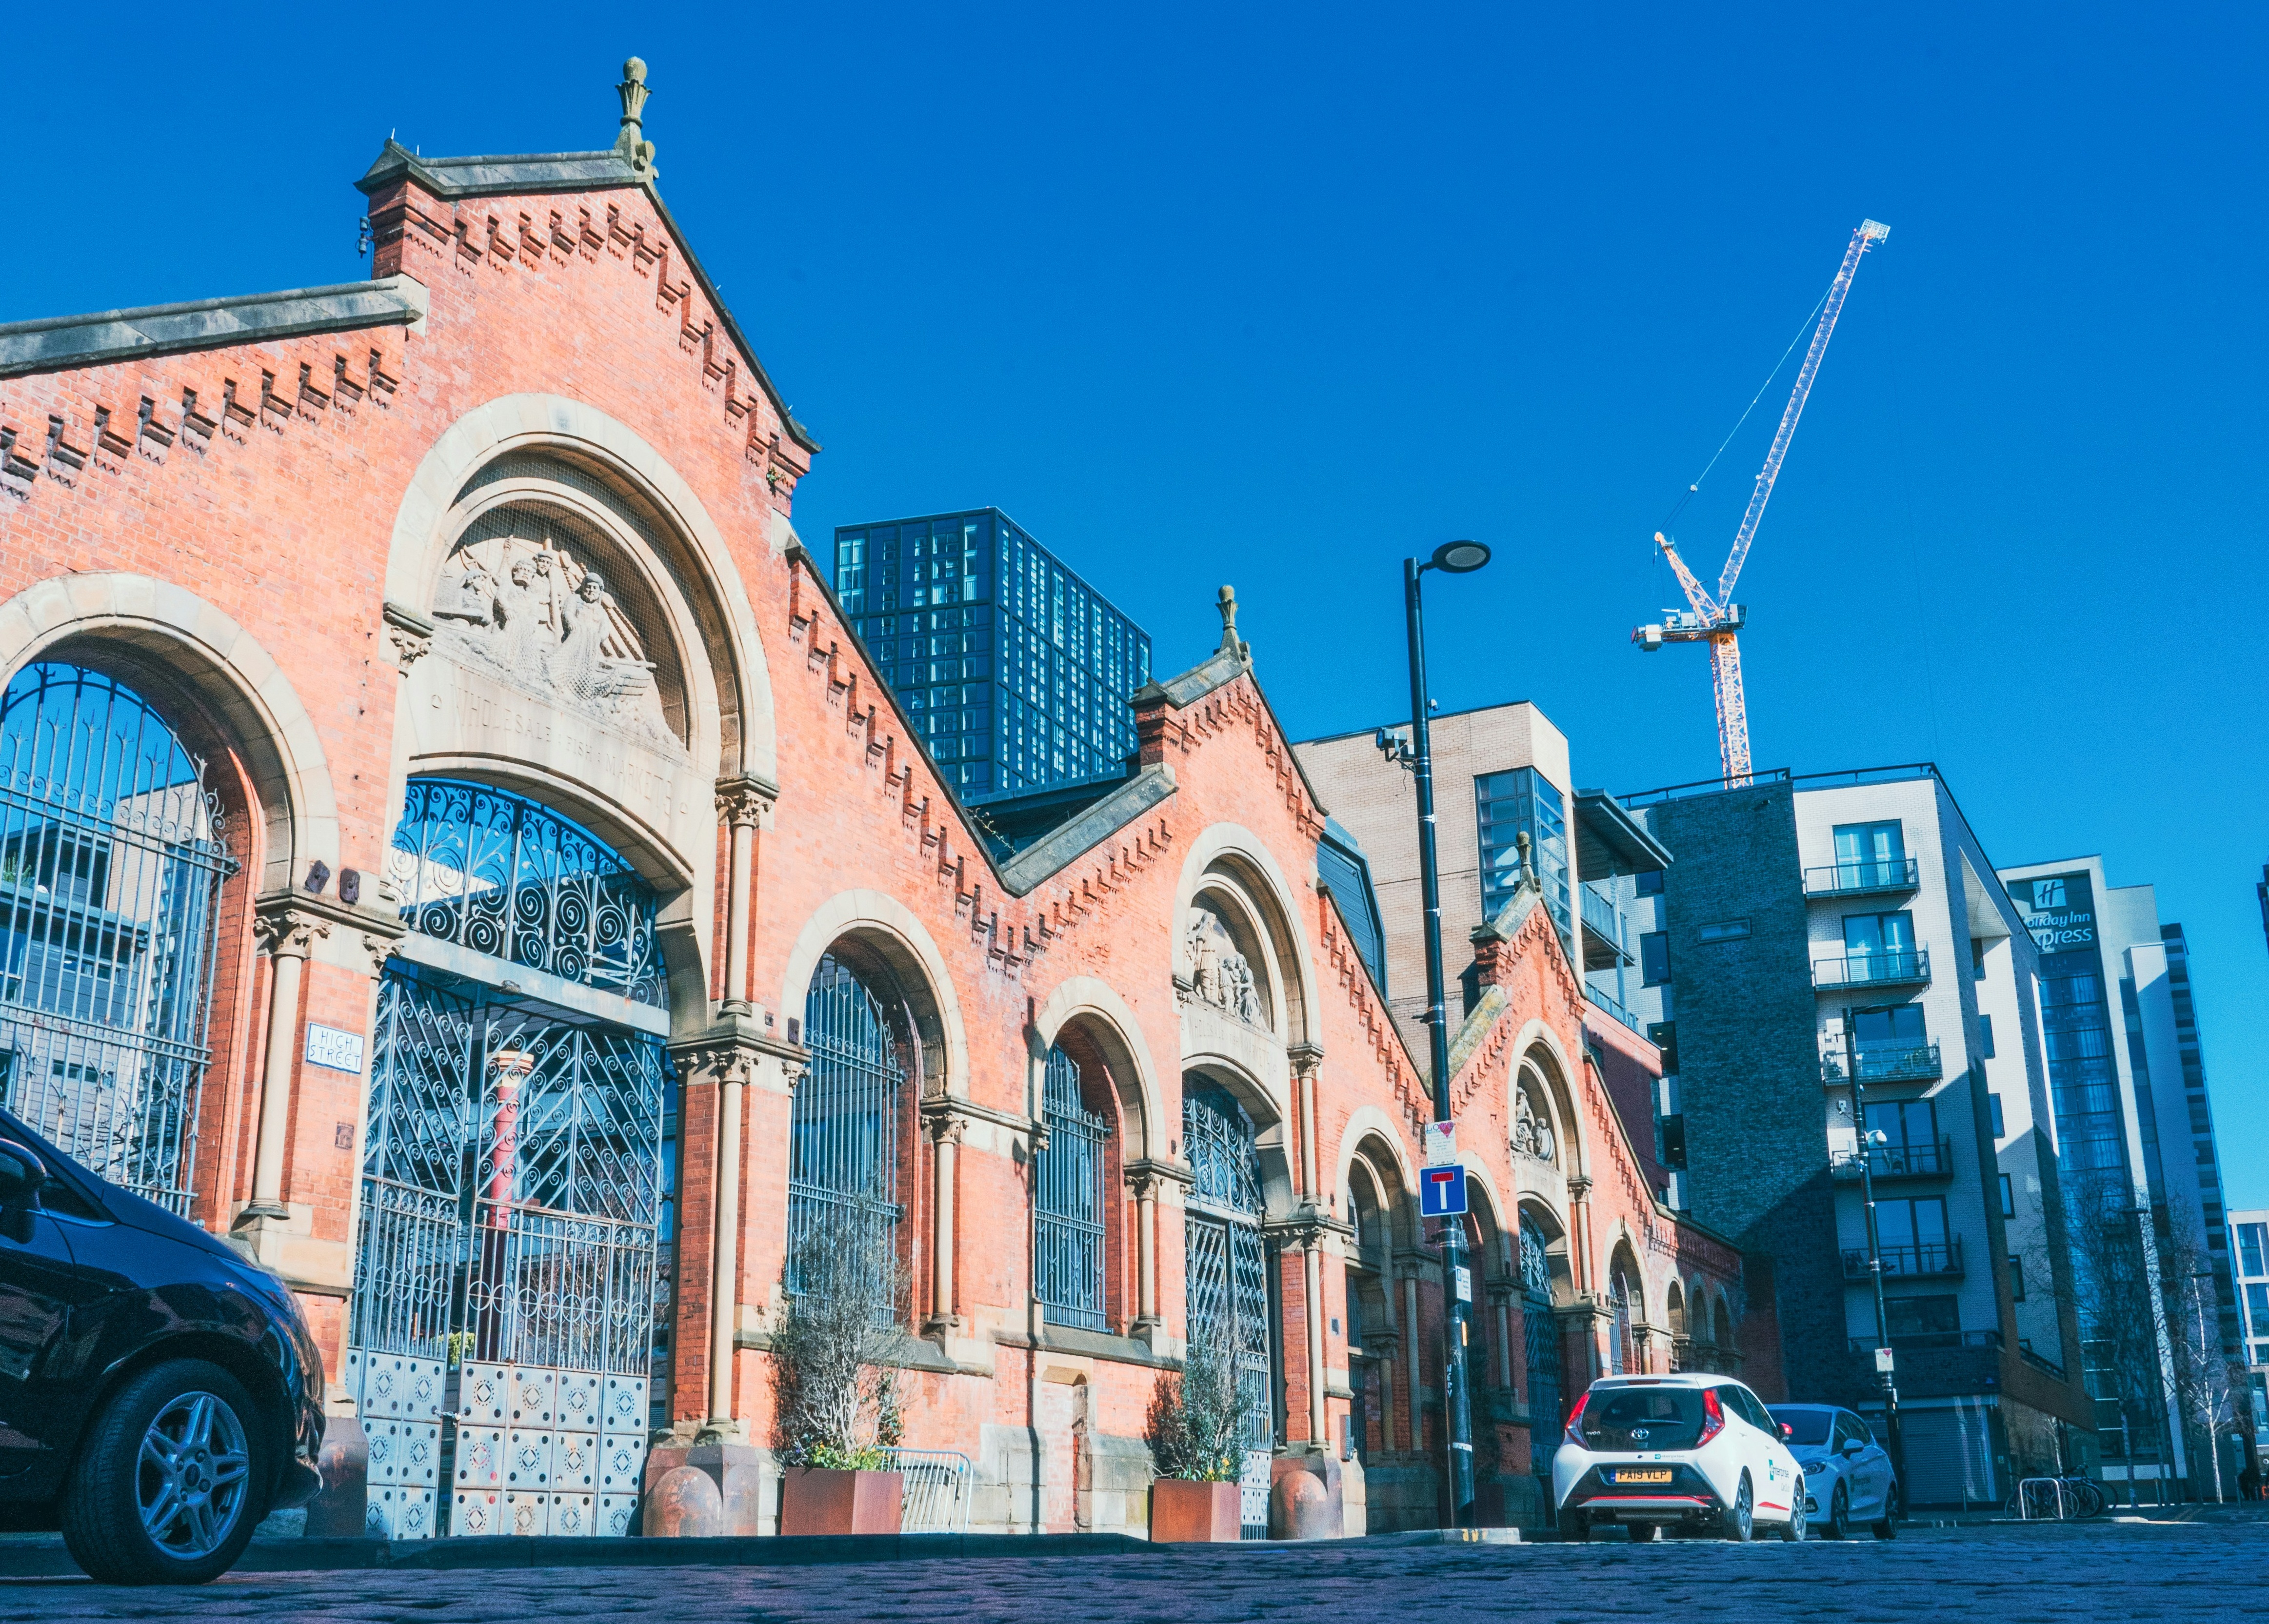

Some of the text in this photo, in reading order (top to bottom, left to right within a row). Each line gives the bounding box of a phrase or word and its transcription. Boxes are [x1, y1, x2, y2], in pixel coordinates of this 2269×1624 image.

[566, 735, 592, 762] FISH
[2070, 911, 2090, 923] Inn
[320, 1030, 353, 1051] HIGH
[310, 1045, 360, 1068] STREET
[1619, 1469, 1667, 1479] FA19 VLP
[1770, 1464, 1789, 1480] enterprise
